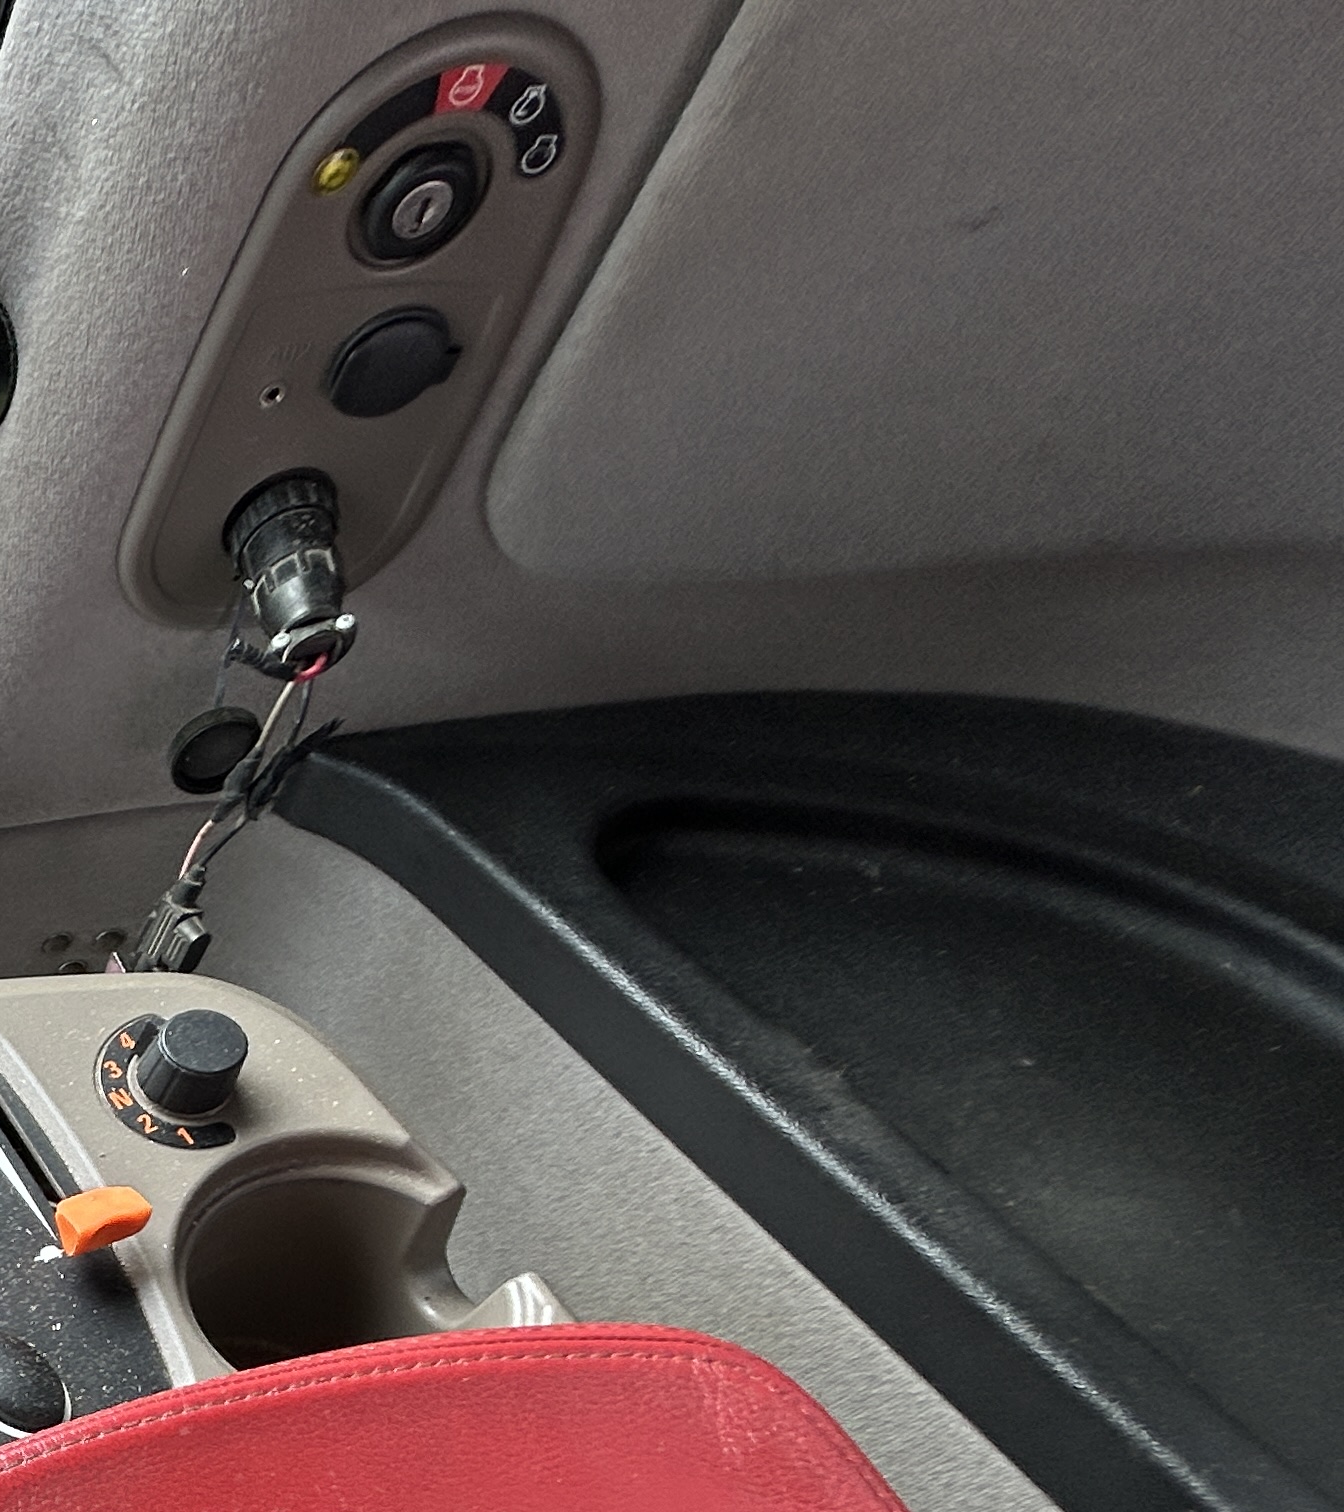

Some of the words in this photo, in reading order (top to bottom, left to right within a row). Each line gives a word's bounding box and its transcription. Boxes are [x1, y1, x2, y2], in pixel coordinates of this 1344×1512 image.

[119, 1031, 136, 1050] 4
[103, 1060, 123, 1079] 3
[137, 1113, 159, 1134] 2
[177, 1127, 194, 1145] 1
